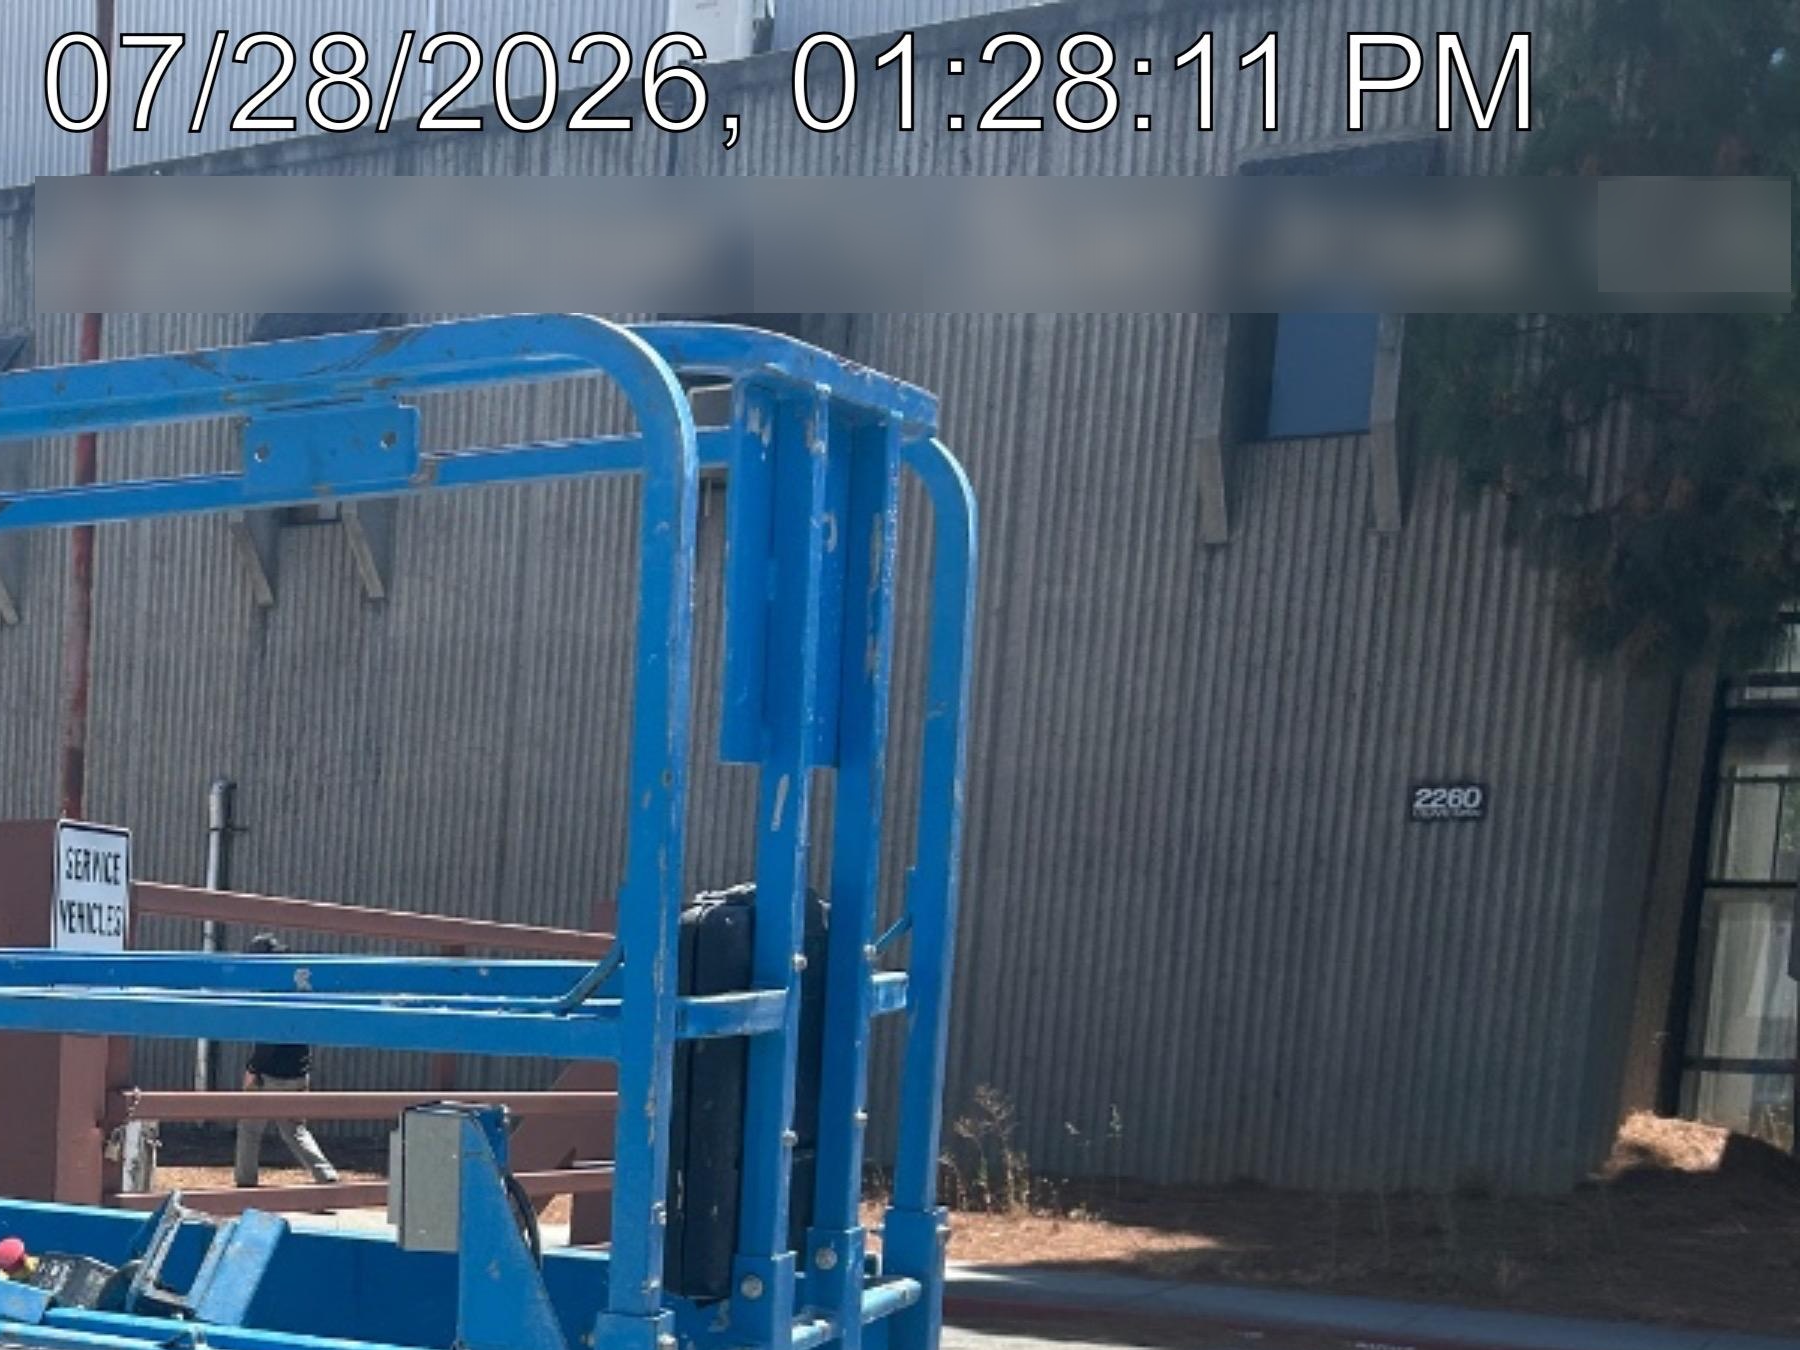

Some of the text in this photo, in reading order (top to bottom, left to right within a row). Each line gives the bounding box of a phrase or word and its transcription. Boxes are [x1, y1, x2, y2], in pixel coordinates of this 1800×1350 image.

[1413, 786, 1482, 808] 2260
[65, 846, 121, 885] SERVICE
[60, 900, 122, 937] VEHICLES
